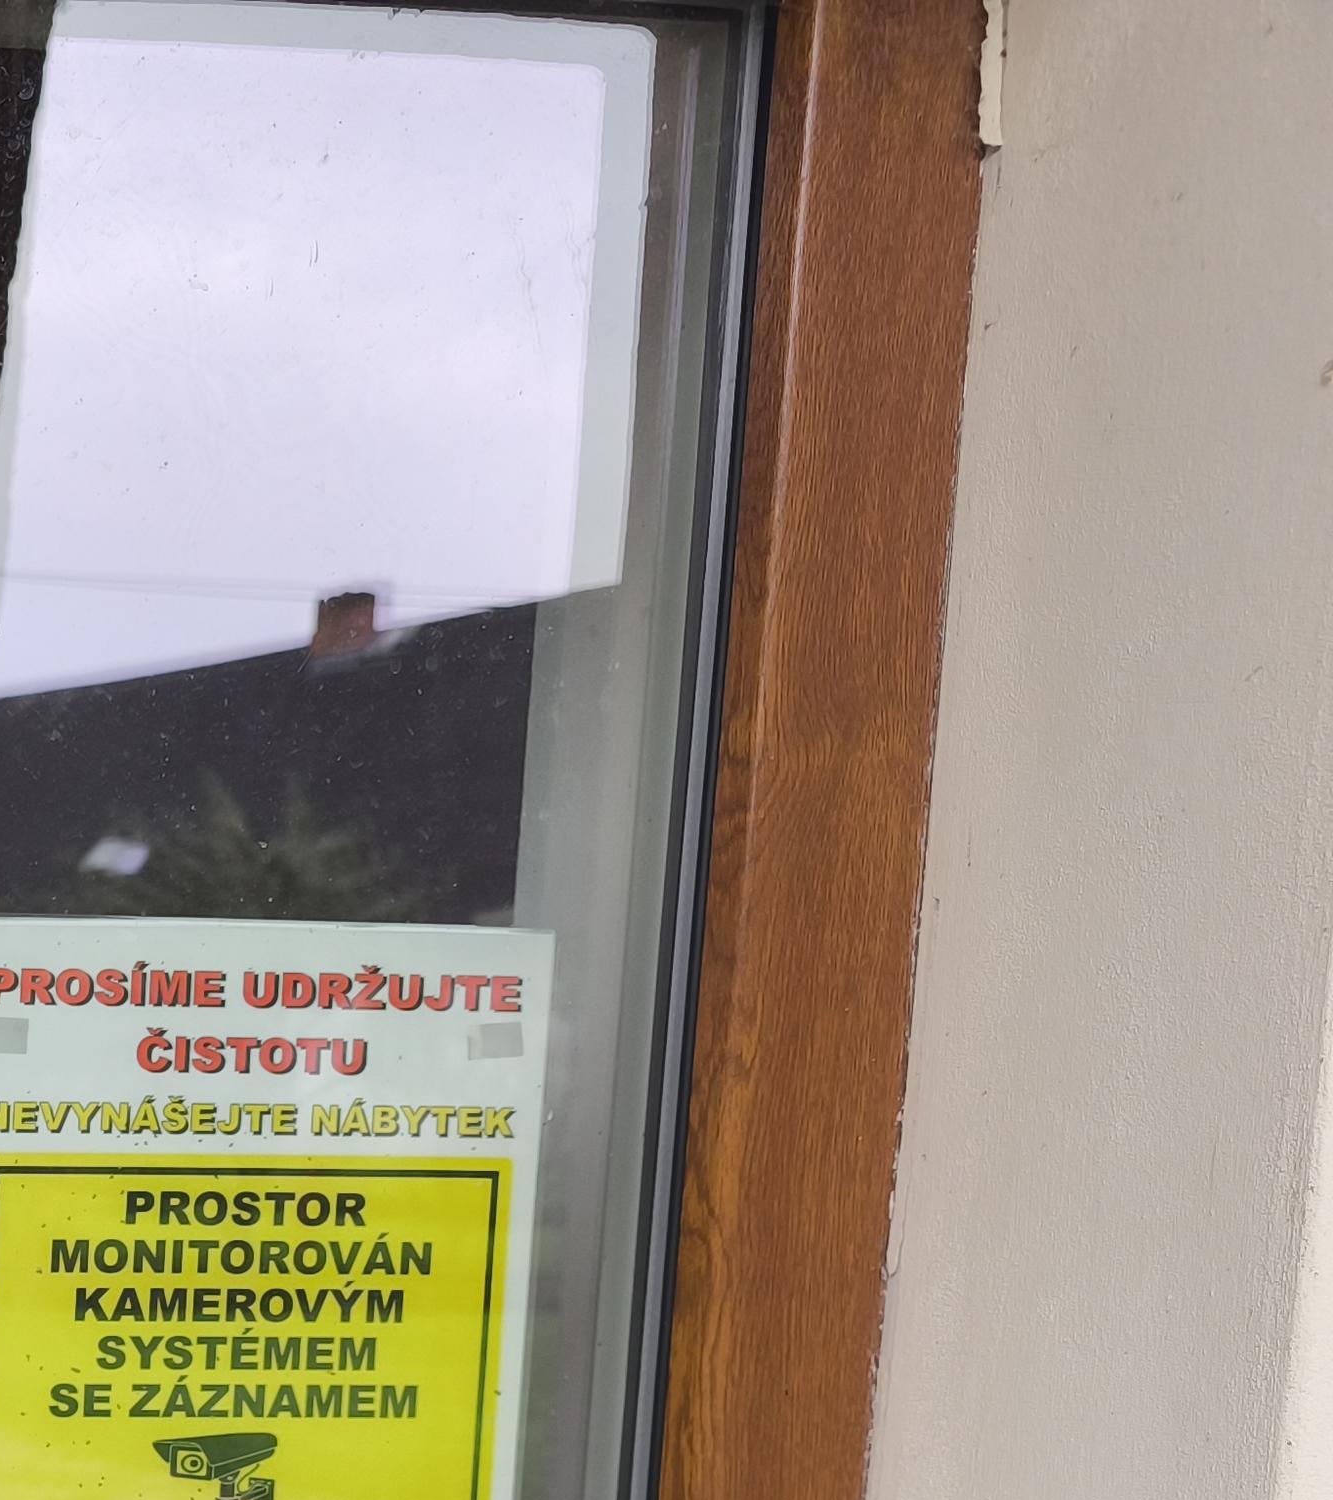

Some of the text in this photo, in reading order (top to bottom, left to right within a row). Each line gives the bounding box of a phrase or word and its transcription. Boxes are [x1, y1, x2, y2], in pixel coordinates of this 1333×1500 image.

[242, 965, 522, 1012] UDRŽUJTE
[136, 1028, 369, 1076] ČISTOTU
[311, 1098, 514, 1138] NÁBYTEK
[125, 1190, 366, 1227] PROSTOR
[50, 1232, 432, 1276] MONITOROVÁN
[74, 1281, 405, 1324] KAMEROVÝM
[96, 1331, 377, 1371] SYSTÉMEM
[49, 1377, 418, 1419] SE ZÁZNAMEM
